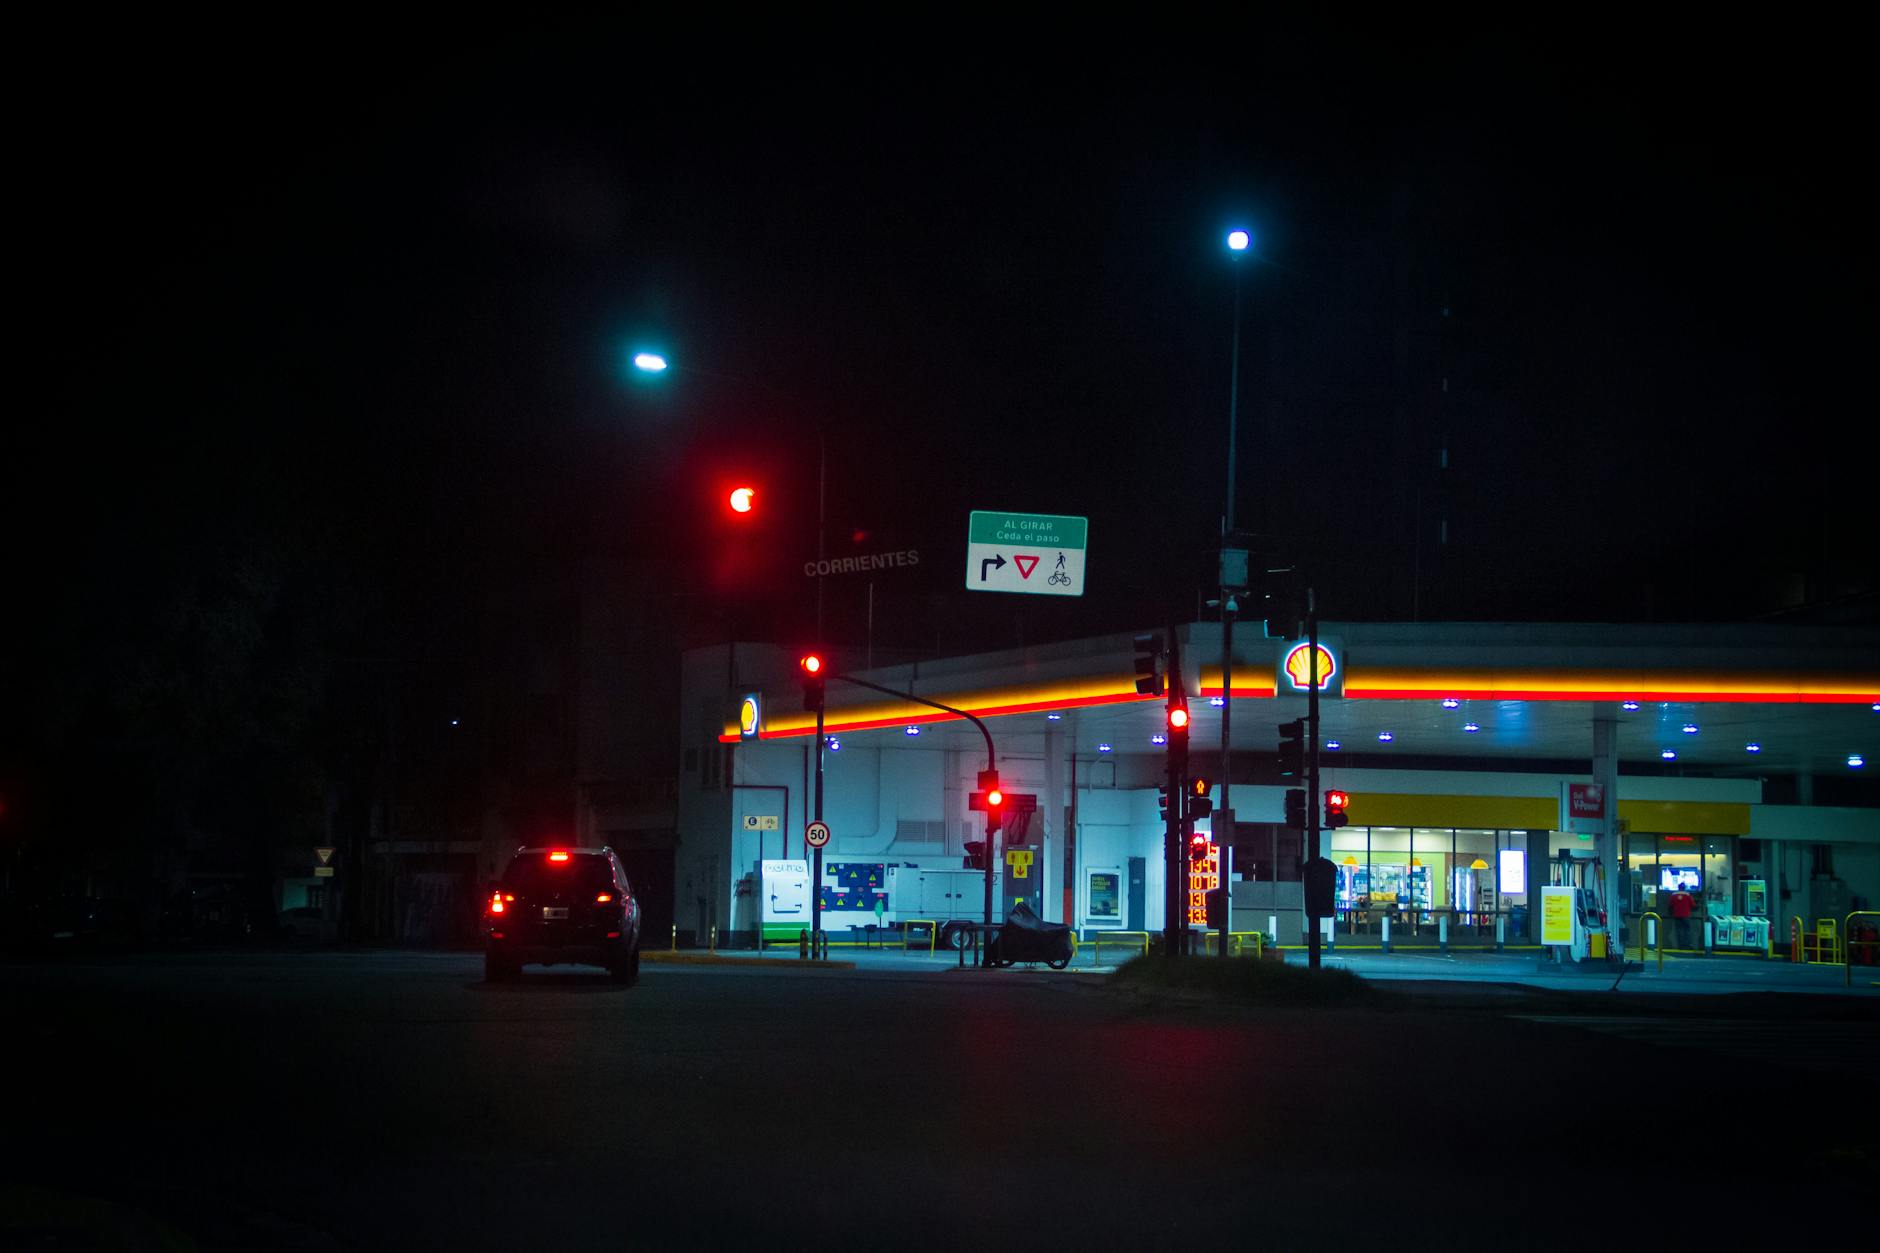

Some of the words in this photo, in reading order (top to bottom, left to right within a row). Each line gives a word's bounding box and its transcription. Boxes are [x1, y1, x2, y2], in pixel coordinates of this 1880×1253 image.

[1004, 520, 1017, 529] AL
[1020, 521, 1053, 531] GIRAR
[996, 530, 1022, 540] Ceda
[1024, 533, 1033, 541] el
[1036, 535, 1060, 543] paso
[803, 549, 920, 577] CORRIENTES
[810, 829, 825, 840] 50
